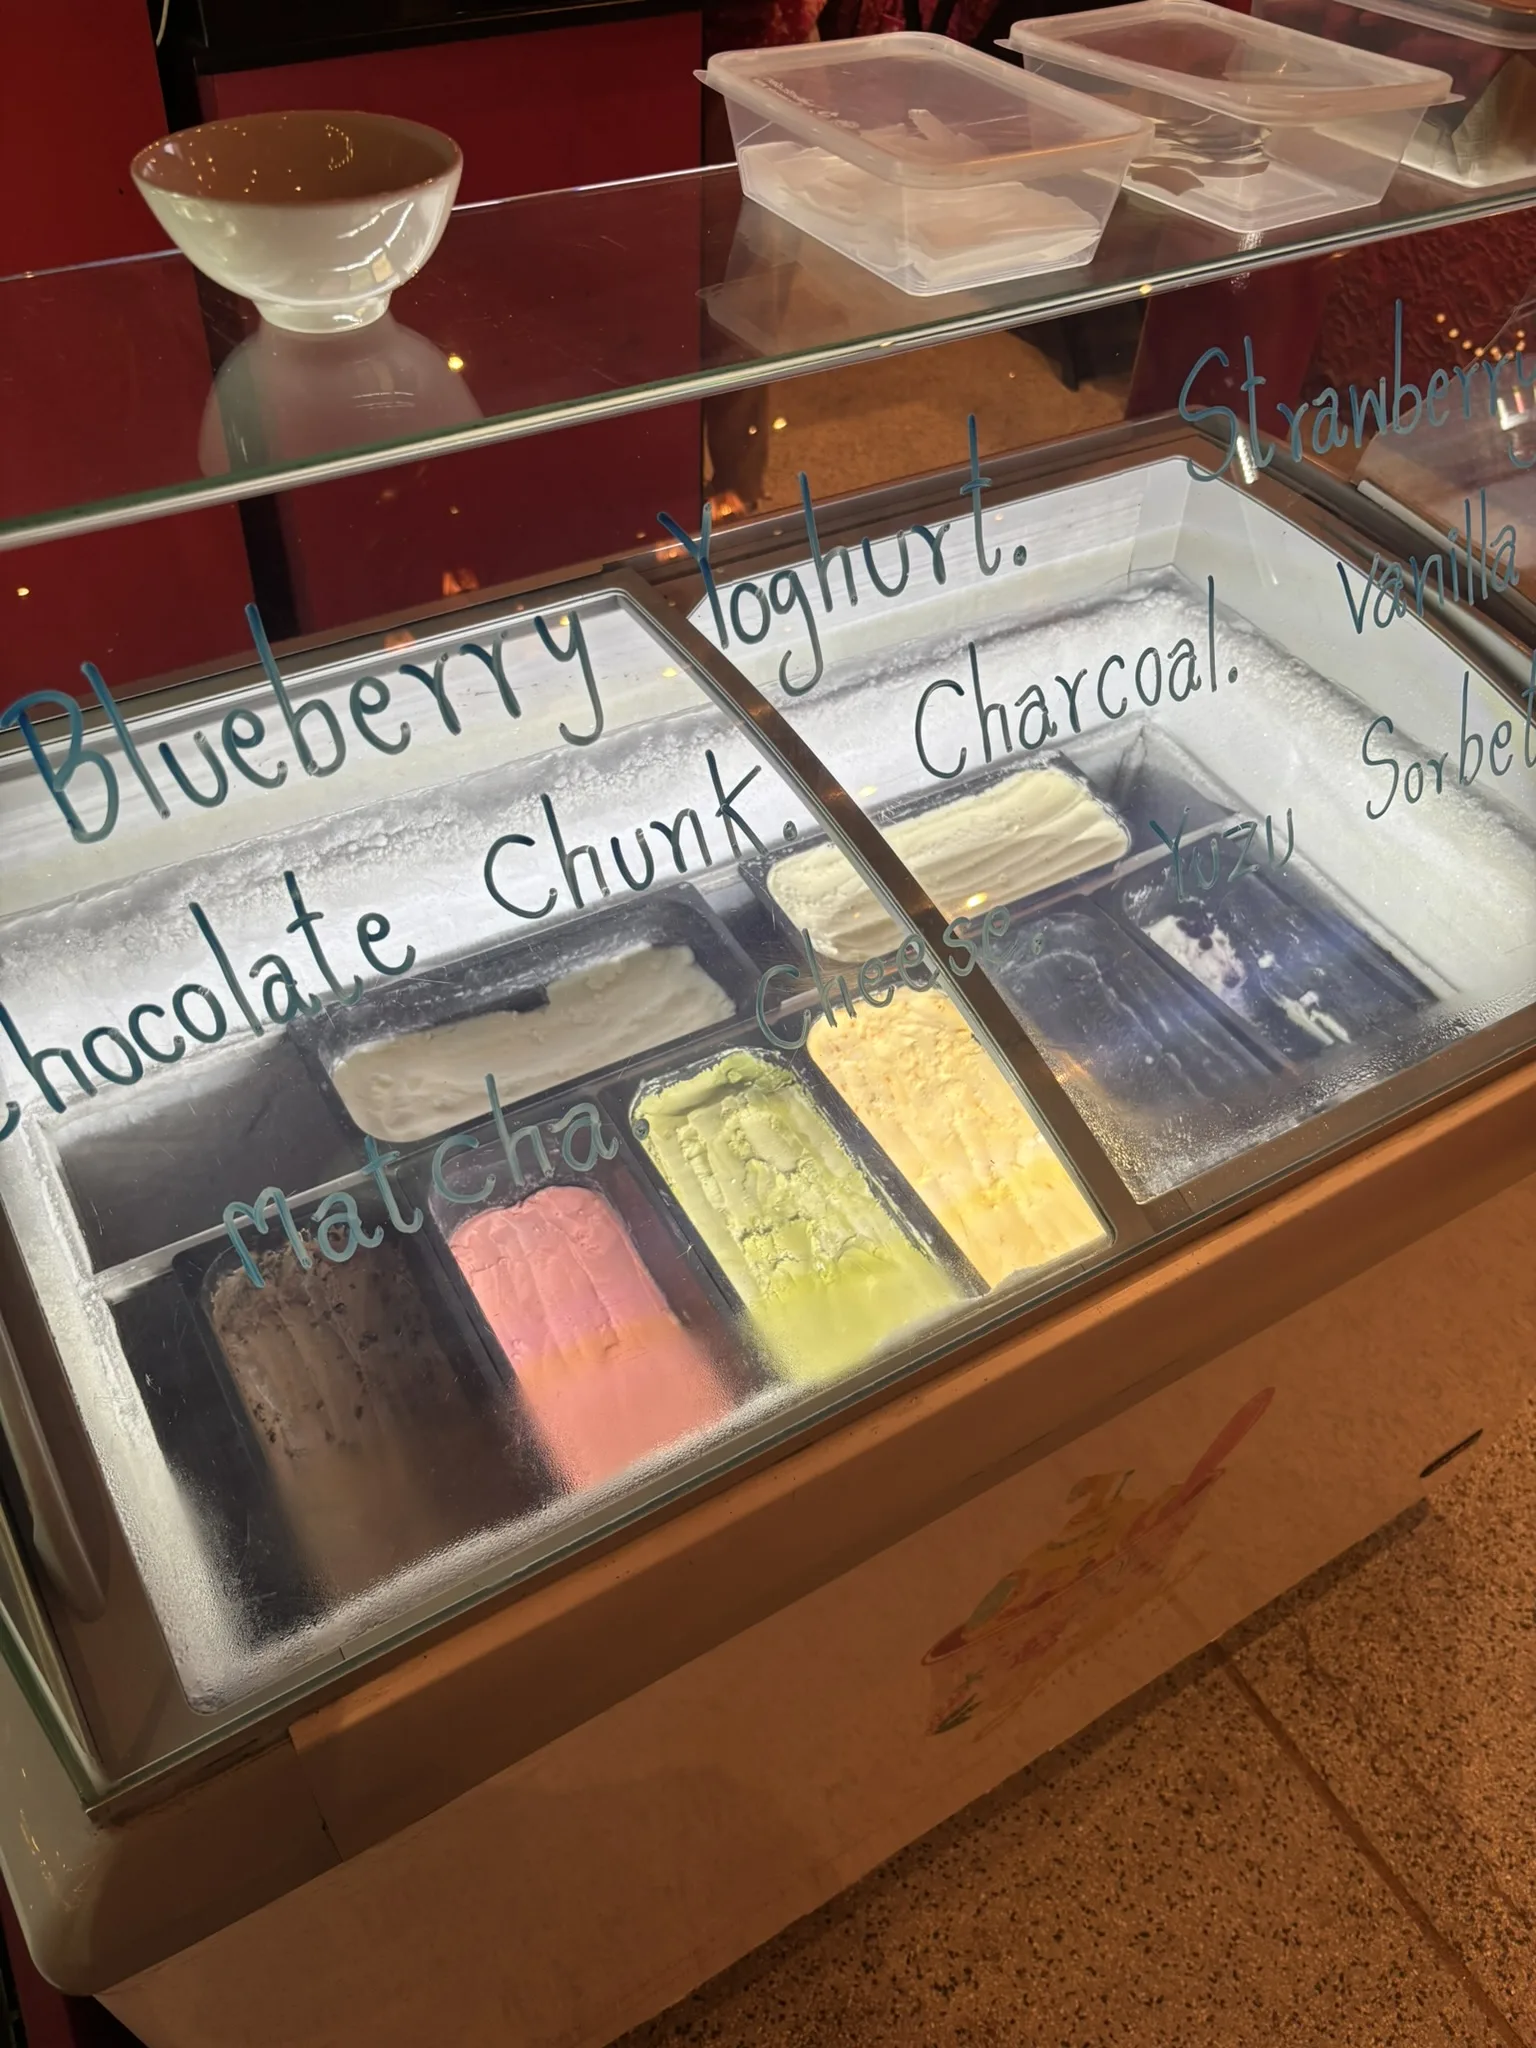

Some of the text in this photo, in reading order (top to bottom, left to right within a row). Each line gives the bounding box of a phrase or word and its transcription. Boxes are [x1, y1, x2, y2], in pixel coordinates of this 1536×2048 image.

[2, 413, 1028, 844] Blueberry Yoghurt.
[1336, 486, 1520, 635] Vanilla
[914, 574, 1239, 780] Charcoal.
[484, 749, 799, 919] Chunk.
[1149, 647, 1536, 904] Yuzu Sorbet
[755, 905, 1047, 1051] Cheese.
